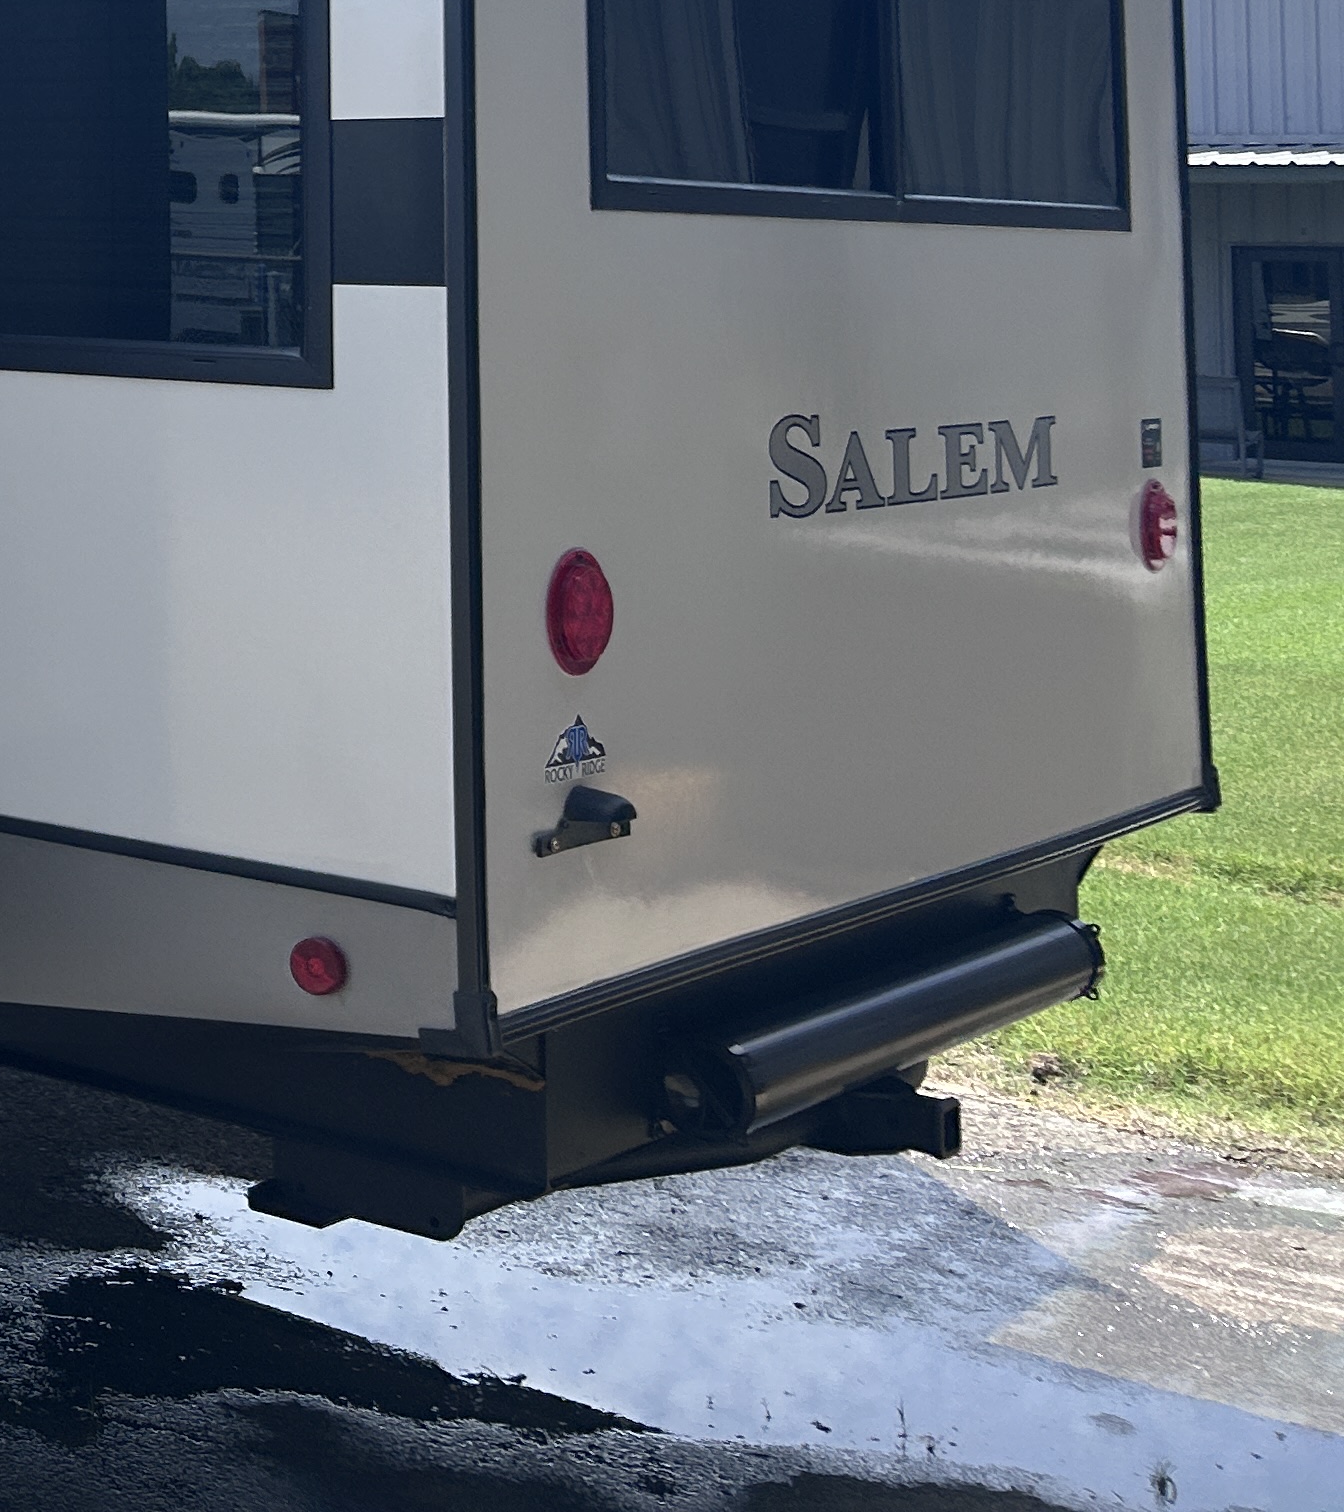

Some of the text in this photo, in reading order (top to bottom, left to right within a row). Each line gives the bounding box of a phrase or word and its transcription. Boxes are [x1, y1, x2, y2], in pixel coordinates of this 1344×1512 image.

[769, 414, 1058, 519] SALEM
[545, 758, 605, 784] ROCKY RIDGE
